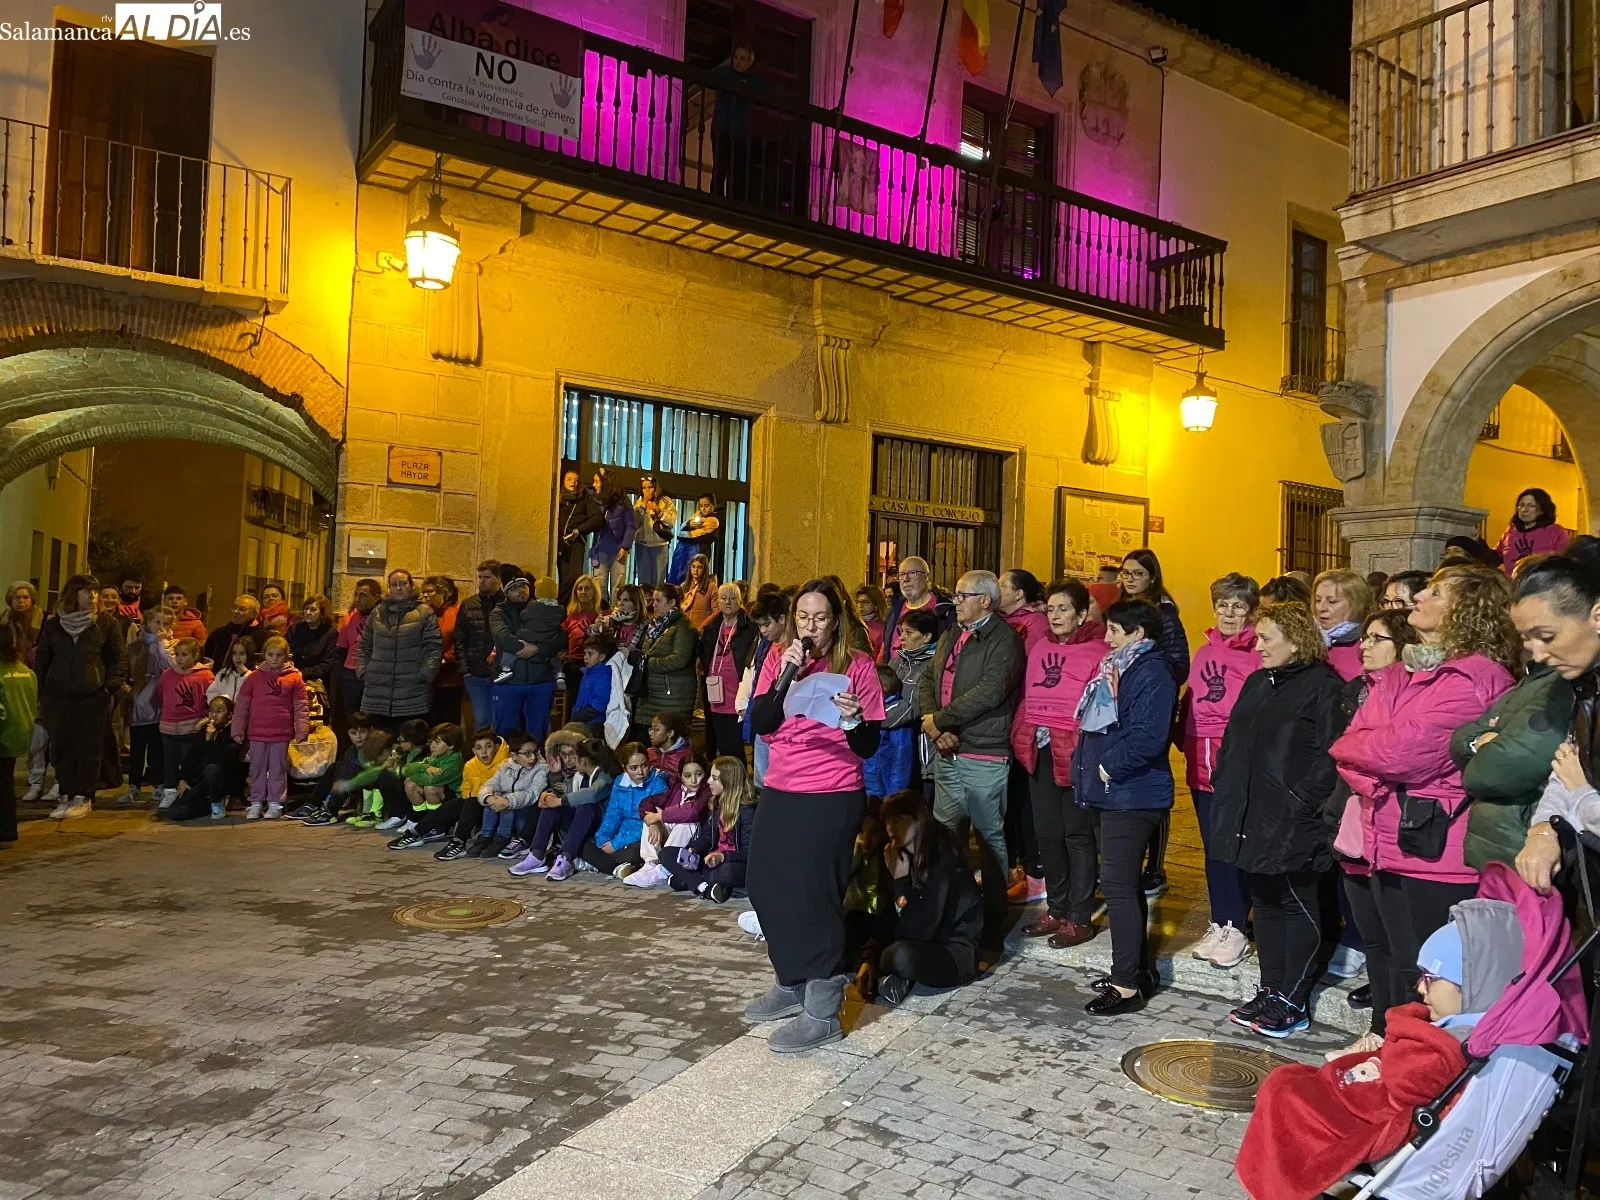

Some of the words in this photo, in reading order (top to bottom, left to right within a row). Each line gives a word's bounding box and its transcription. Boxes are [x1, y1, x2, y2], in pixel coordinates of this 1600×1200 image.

[427, 11, 494, 51] Alba
[504, 37, 561, 70] dice
[475, 52, 518, 85] NO
[406, 69, 425, 83] Día
[427, 77, 463, 93] contra
[465, 84, 475, 96] la
[477, 89, 523, 110] violencia
[526, 102, 540, 114] de
[541, 107, 576, 125] género
[467, 76, 477, 85] 25
[480, 81, 525, 98] noviembre
[481, 103, 491, 112] de
[491, 106, 524, 122] Bienestar
[525, 115, 546, 128] Social
[401, 460, 429, 471] PLAZA
[401, 470, 429, 480] MAYOR
[882, 501, 910, 514] CASA
[915, 504, 928, 516] DE
[932, 507, 980, 521] CONCEJO
[1415, 1126, 1475, 1198] Inglesina
